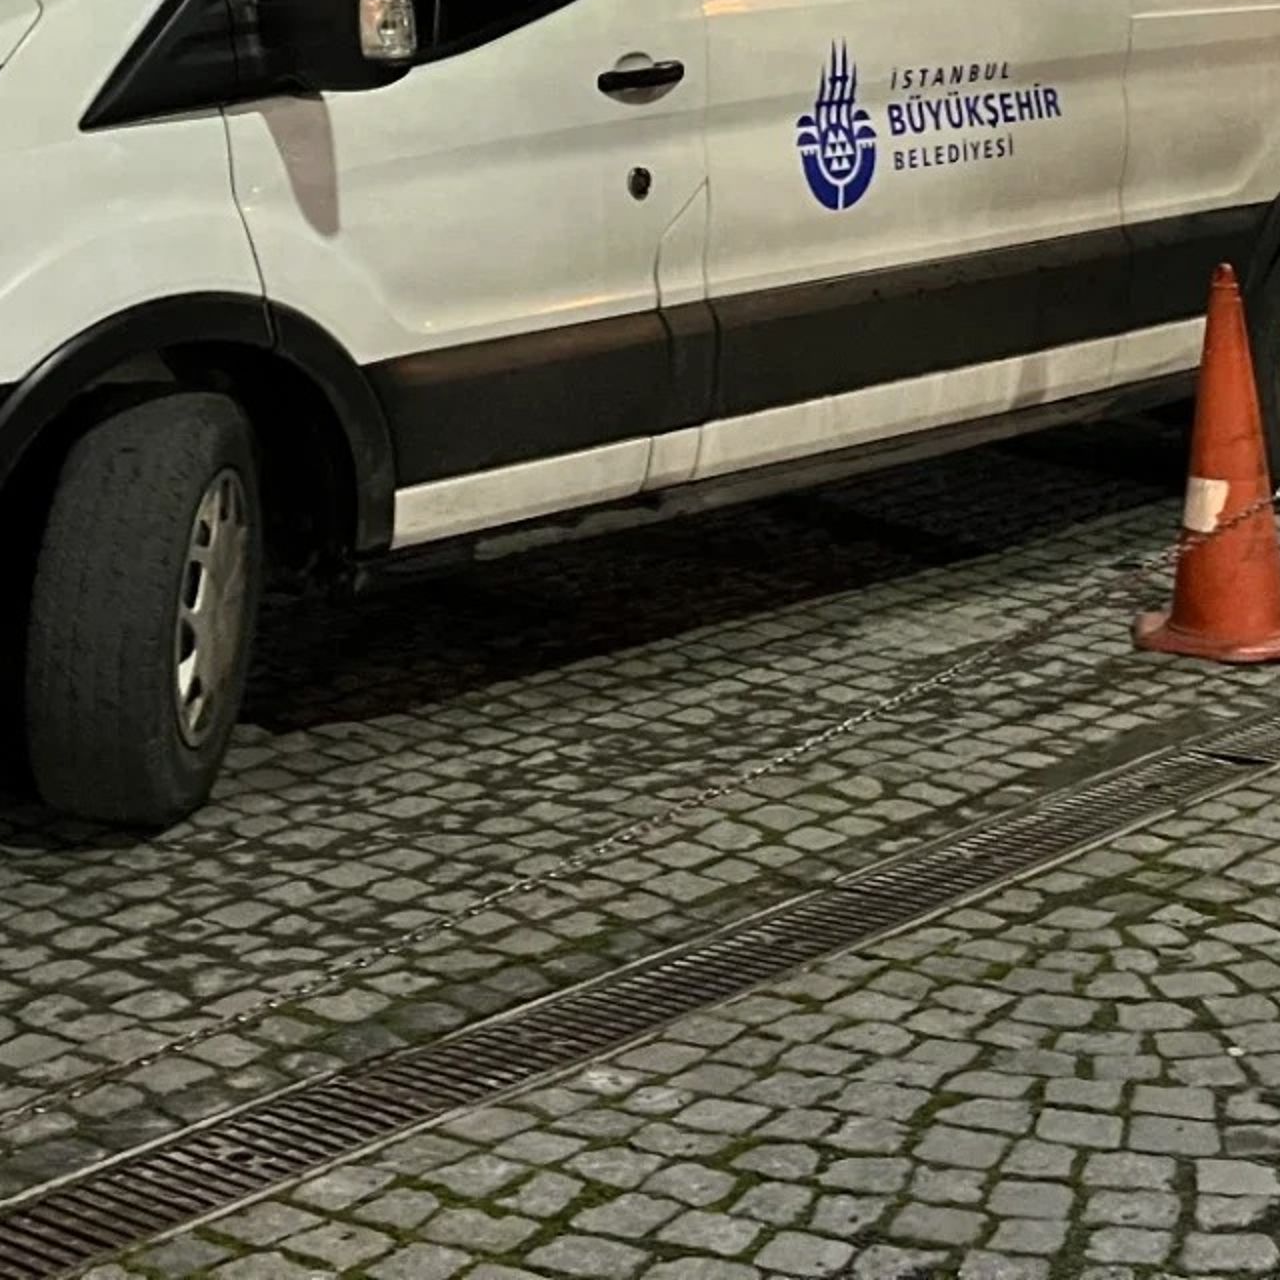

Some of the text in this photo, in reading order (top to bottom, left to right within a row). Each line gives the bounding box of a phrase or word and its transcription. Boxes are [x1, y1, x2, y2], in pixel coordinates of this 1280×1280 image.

[891, 62, 1009, 90] İSTANBUL
[888, 83, 1061, 136] BÜYÜKŞEHİR
[894, 133, 1014, 170] BELEDİYESİ
